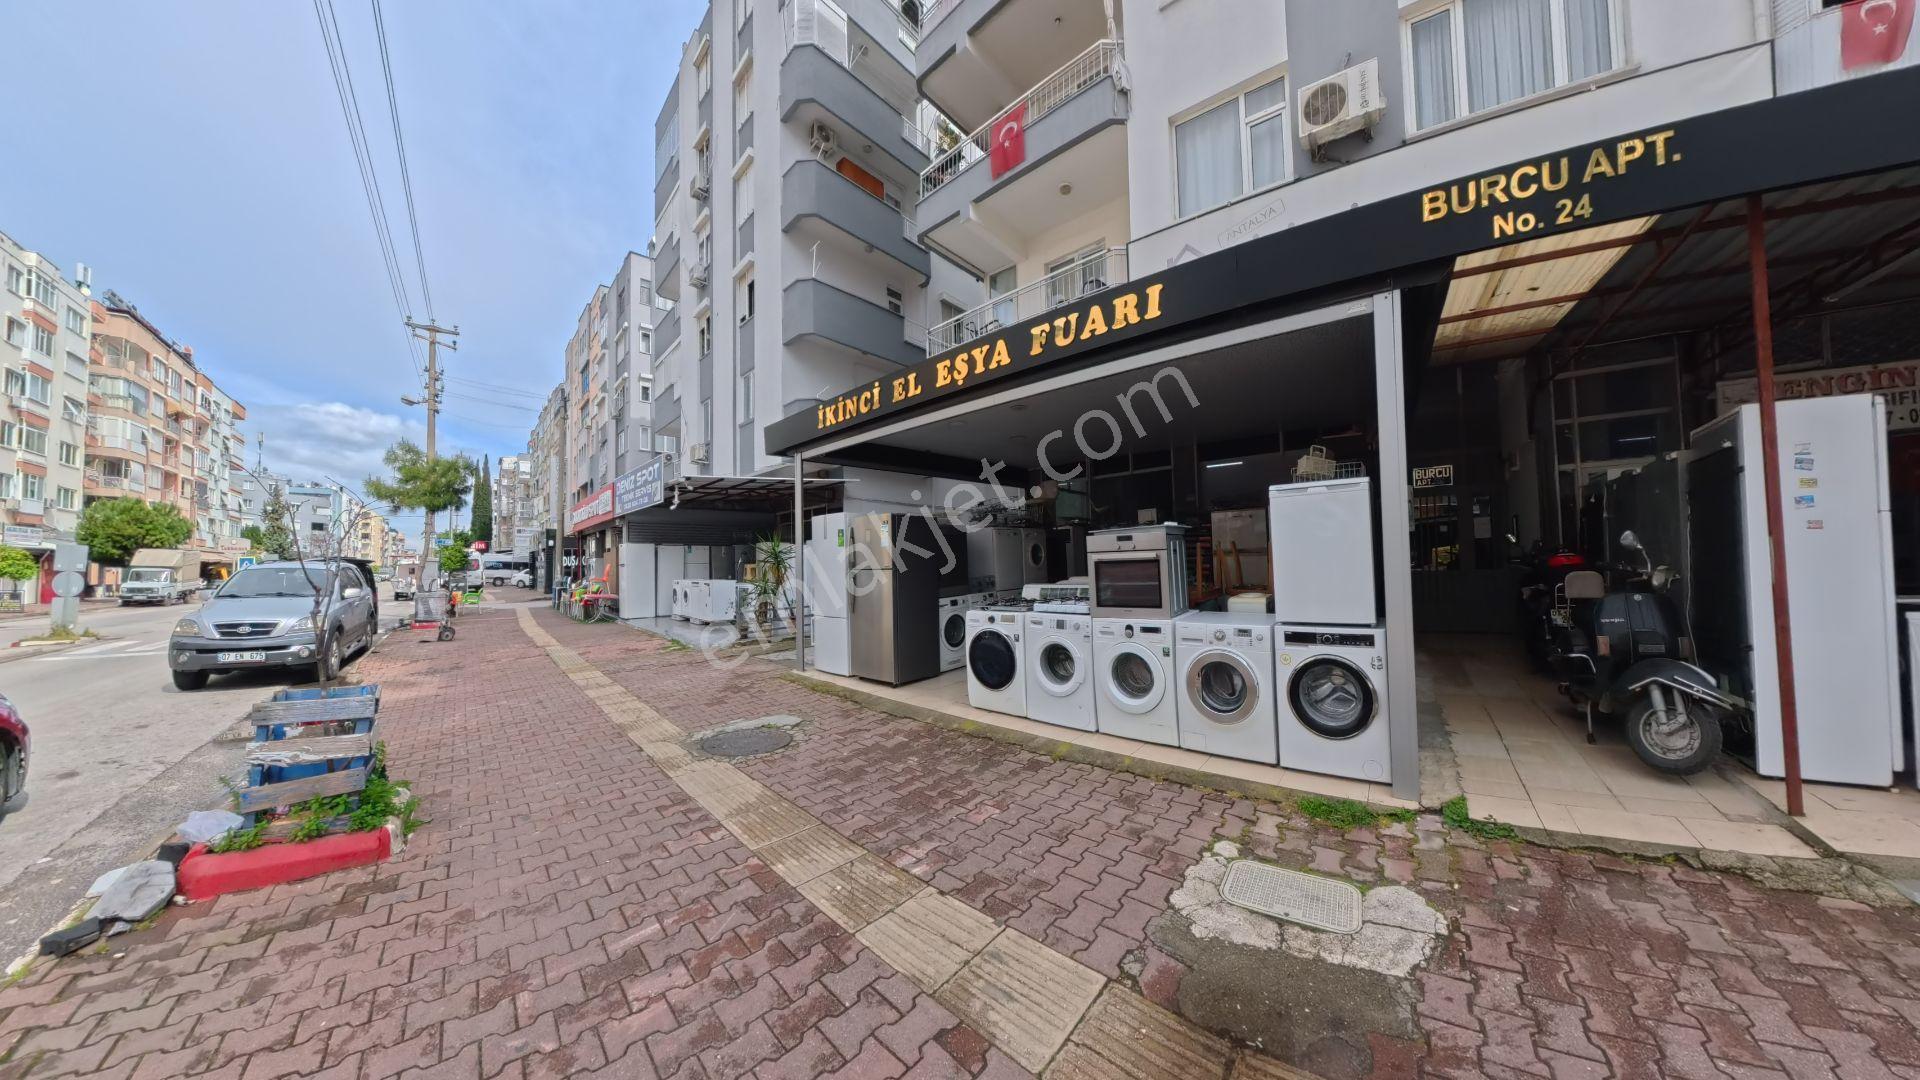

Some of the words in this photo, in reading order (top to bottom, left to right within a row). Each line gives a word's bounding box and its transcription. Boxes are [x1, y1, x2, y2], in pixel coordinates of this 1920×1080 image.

[1422, 157, 1569, 222] BURCU
[1582, 130, 1682, 183] APT.
[1493, 211, 1544, 239] No.
[1555, 193, 1593, 225] 24
[817, 382, 881, 429] İKİNCİ
[892, 372, 922, 403] EL
[935, 339, 1011, 386] EŞYA
[1029, 283, 1164, 356] FUARI
[616, 474, 635, 496] DENİZ
[636, 463, 660, 486] SPOT
[1415, 468, 1449, 479] BURCU
[222, 653, 231, 661] 07
[250, 652, 264, 660] 675
